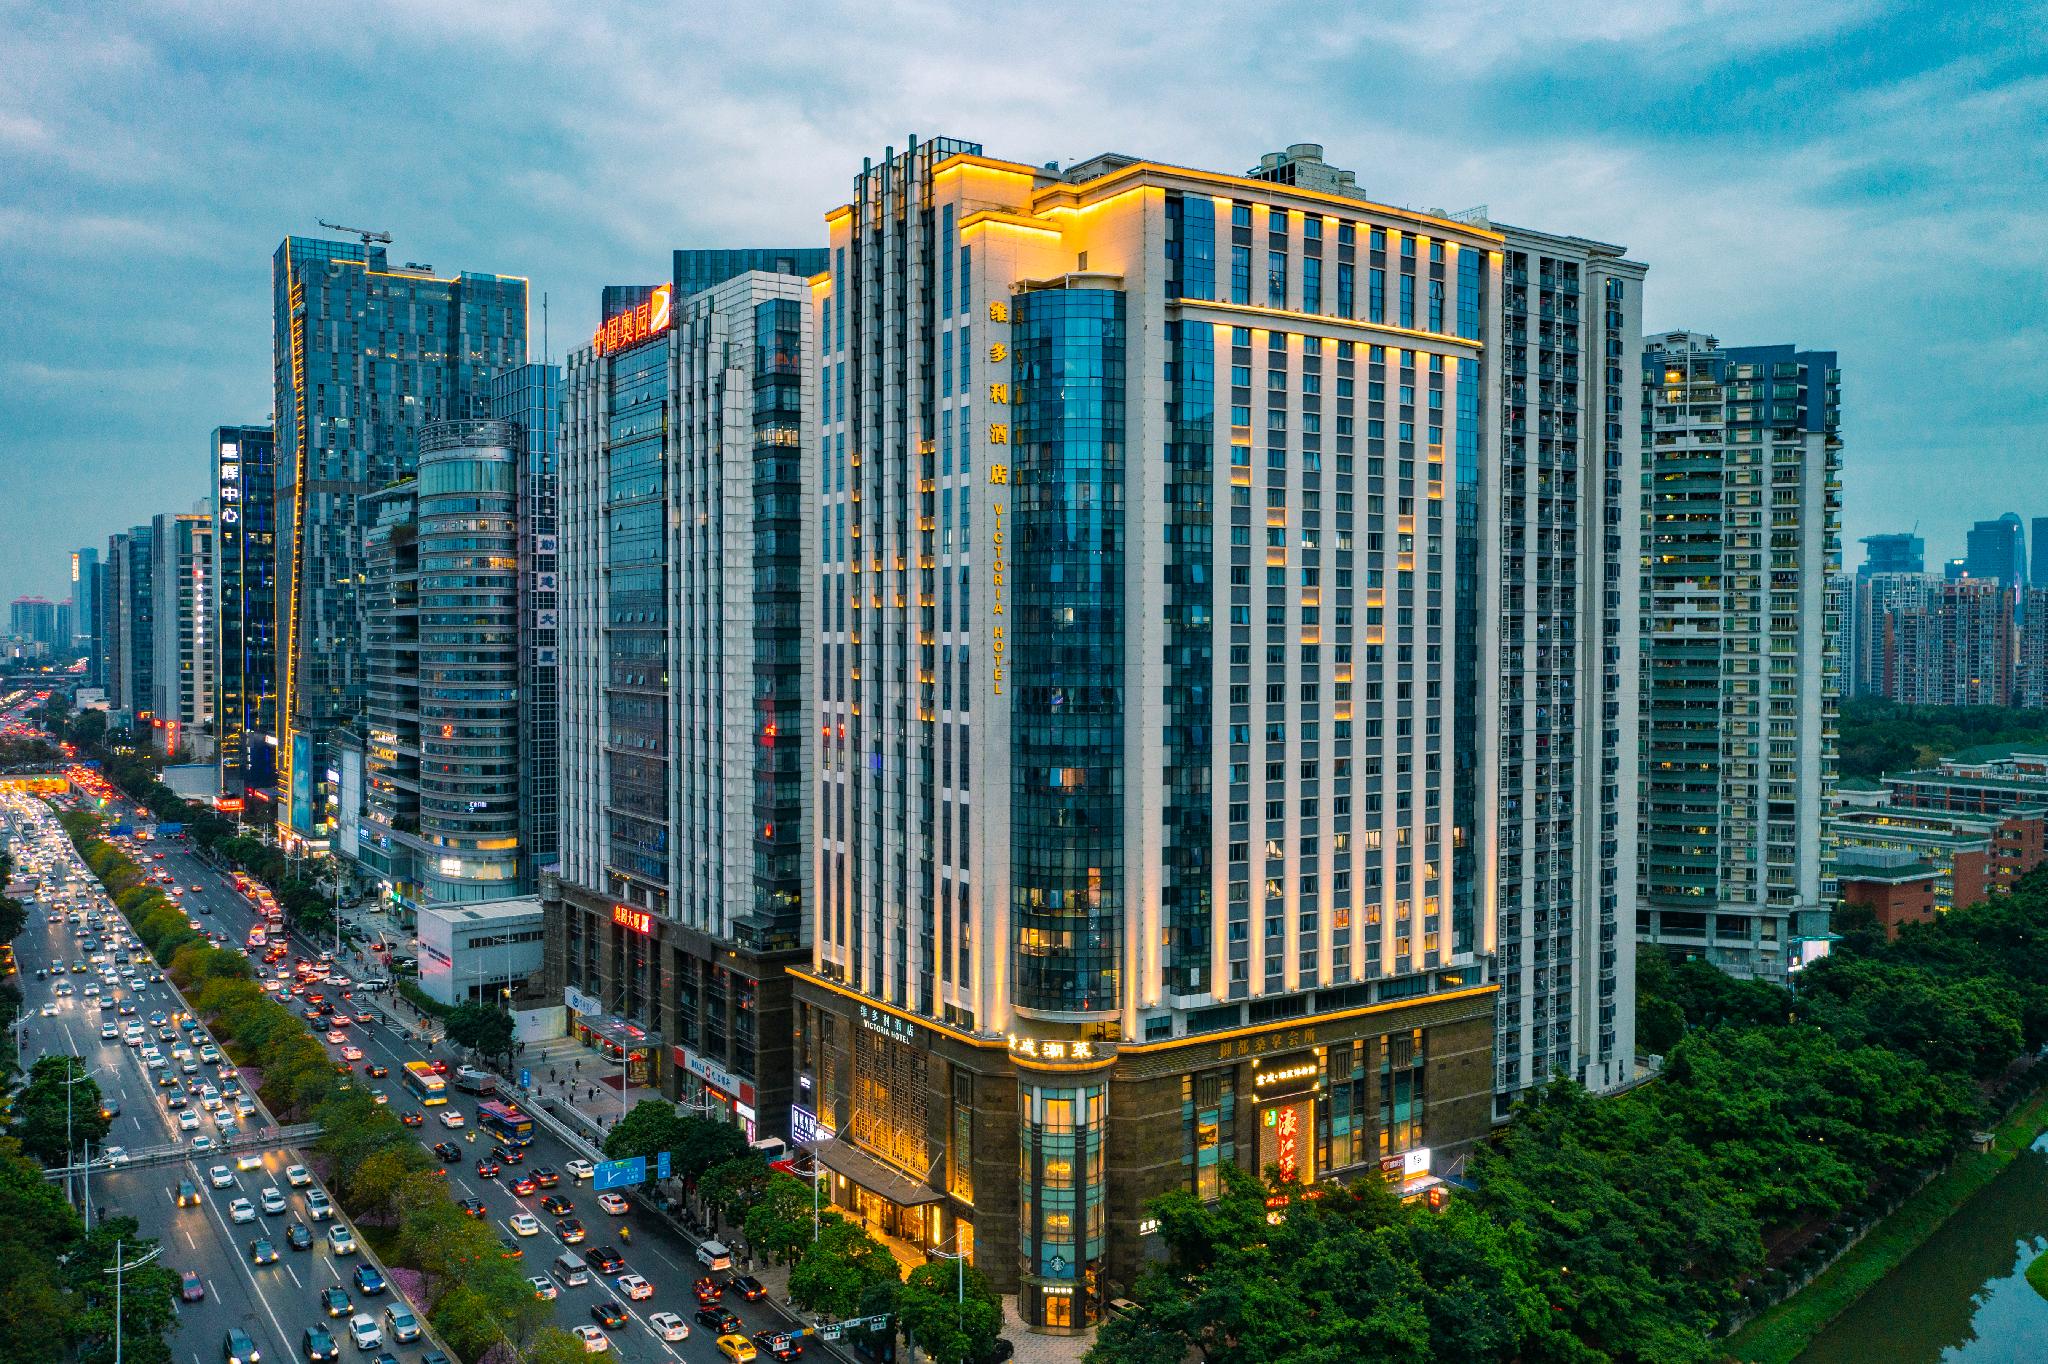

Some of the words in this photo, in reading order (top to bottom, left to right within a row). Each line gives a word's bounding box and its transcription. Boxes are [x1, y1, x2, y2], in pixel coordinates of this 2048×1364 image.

[593, 303, 648, 356] 中国奥园
[989, 302, 1008, 485] 维多利酒店
[993, 503, 1004, 614] VICTORIA
[993, 626, 1004, 695] HOTEL
[860, 1004, 914, 1037] 维多利酒店
[863, 1019, 890, 1037] VICTORIA
[891, 1031, 910, 1045] HOTEL
